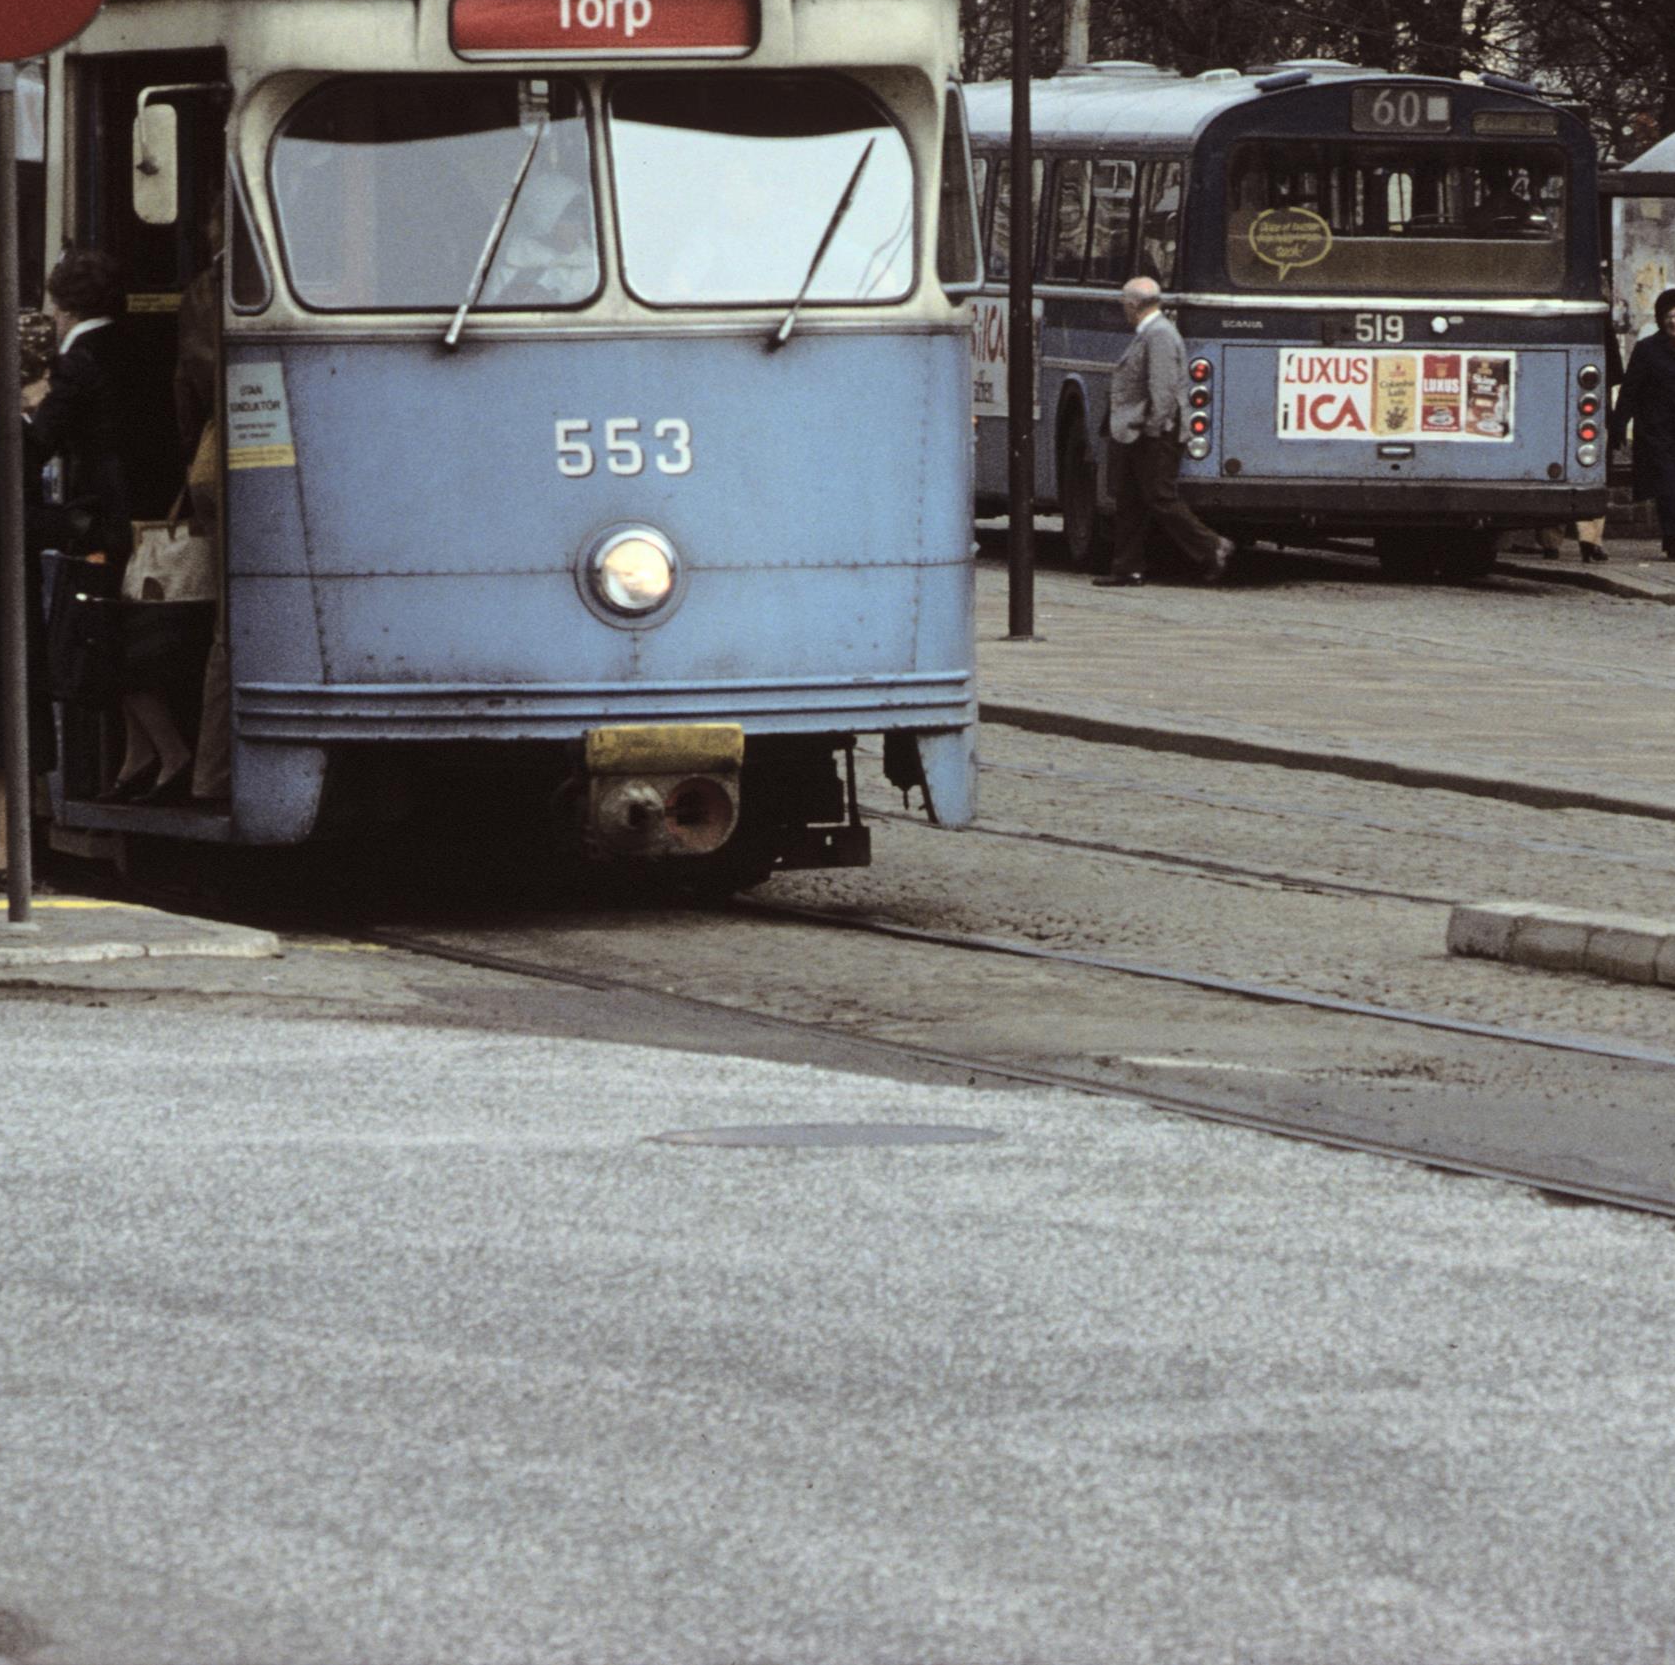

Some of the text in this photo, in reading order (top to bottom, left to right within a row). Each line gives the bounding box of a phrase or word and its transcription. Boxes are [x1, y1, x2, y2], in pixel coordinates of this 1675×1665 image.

[1372, 89, 1421, 128] 60
[1221, 320, 1264, 329] SCANIA
[1355, 313, 1404, 343] 519
[1284, 353, 1369, 385] LUXUS
[1423, 378, 1460, 393] LUXUS
[1282, 394, 1367, 432] i ICA
[555, 417, 692, 476] 553
